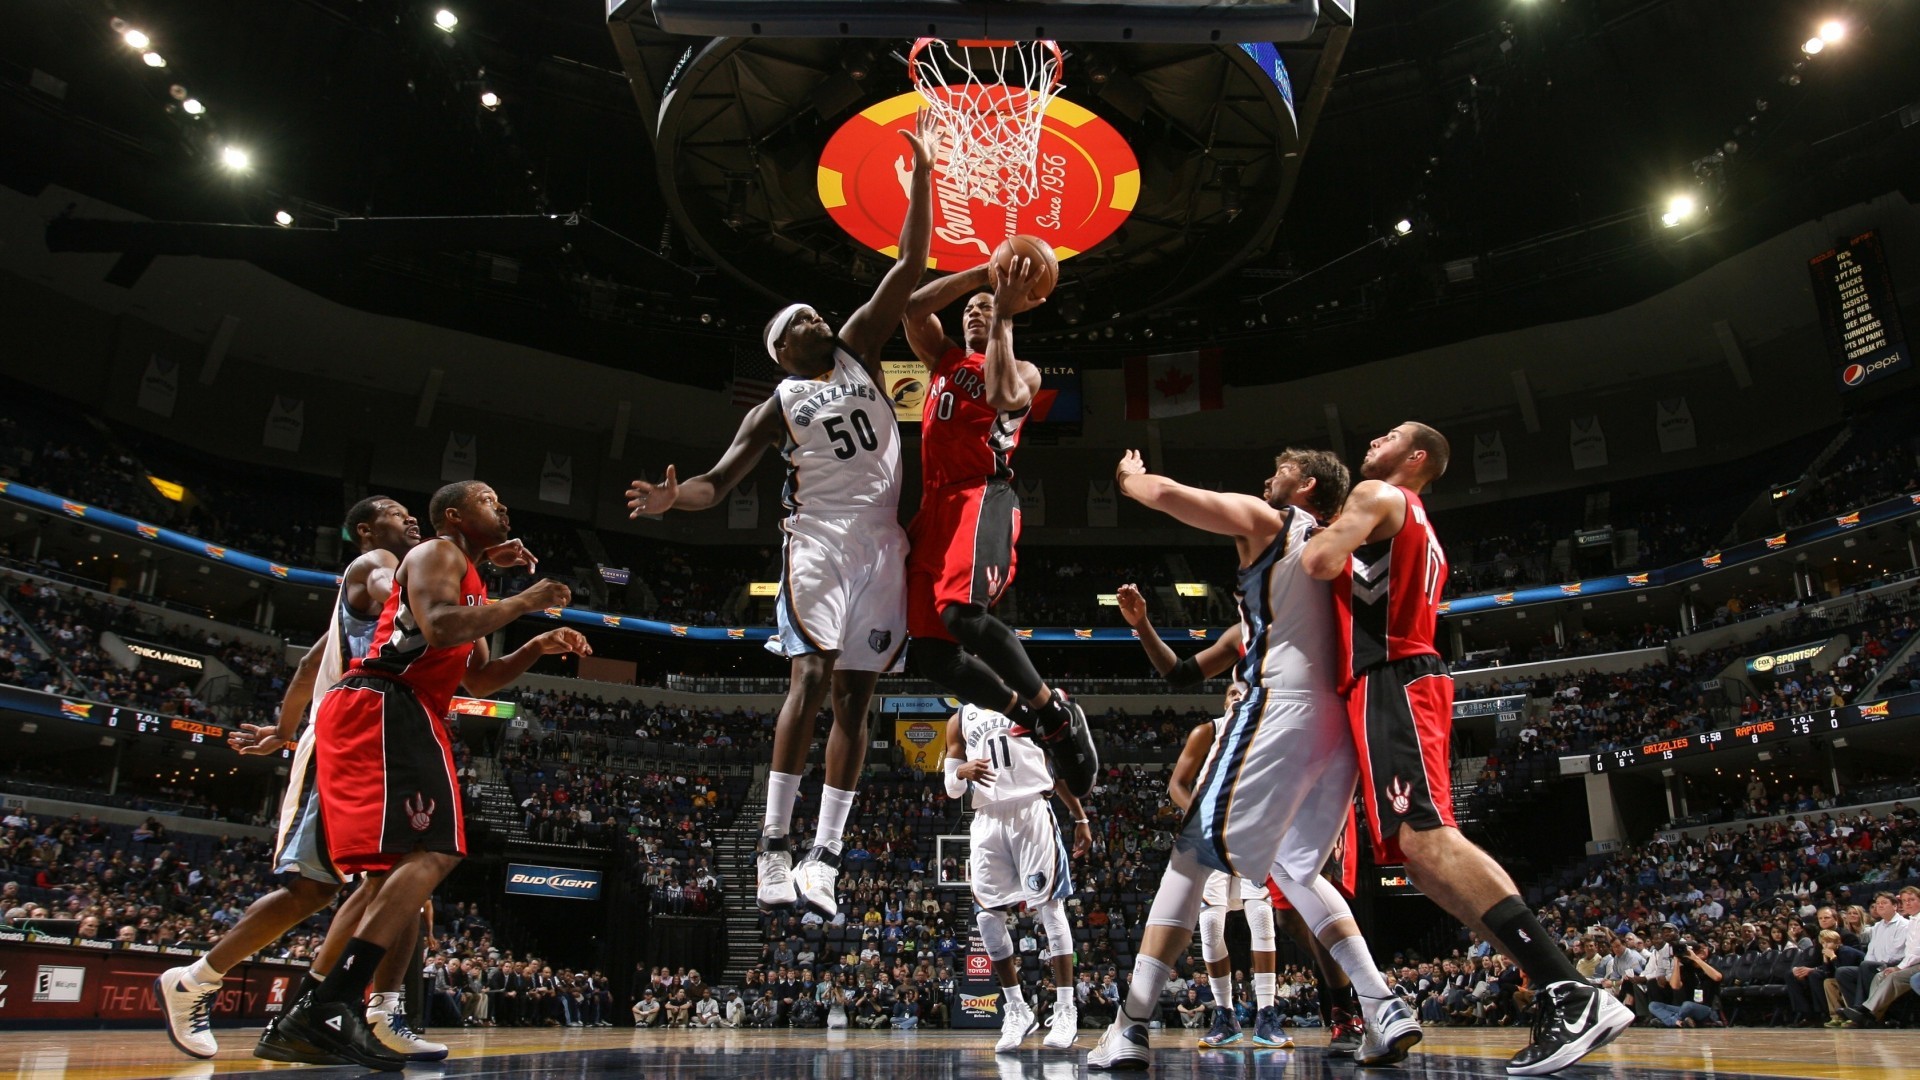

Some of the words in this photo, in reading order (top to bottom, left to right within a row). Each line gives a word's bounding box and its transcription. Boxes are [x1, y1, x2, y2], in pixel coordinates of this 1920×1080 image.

[1041, 153, 1067, 195] 1956
[1036, 196, 1062, 230] Since
[1836, 250, 1852, 262] FG%
[1839, 260, 1854, 270] FT%
[1840, 270, 1848, 280] PT
[1849, 264, 1862, 276] FGS
[1838, 276, 1862, 292] BLOCKS
[1841, 285, 1865, 300] STEALS
[1842, 294, 1868, 310] ASSISTS
[1857, 303, 1872, 314] REB.
[1860, 313, 1875, 324] REB.
[1844, 320, 1881, 340] TURNOVERS
[1844, 342, 1857, 351] PTS
[1858, 338, 1865, 346] IN
[1866, 328, 1884, 342] PAINT
[1848, 344, 1876, 360] FASTBREAK
[1876, 338, 1886, 348] PTS
[1866, 352, 1900, 374] pepsi
[930, 367, 987, 400] RAORS
[795, 383, 876, 427] GRIZZLIES
[822, 408, 878, 460] 50
[1628, 574, 1648, 583] SONIC
[162, 652, 202, 669] MINOLTA
[1758, 658, 1770, 666] FOX
[1777, 664, 1794, 673] 116A
[1704, 680, 1718, 689] 116A
[1830, 710, 1836, 718] F
[1861, 704, 1887, 716] SONIC
[109, 717, 118, 727] 0
[138, 722, 146, 732] 6
[171, 720, 222, 737] GRIZZLIES
[1802, 724, 1810, 734] 5
[1831, 719, 1838, 728] 0
[968, 717, 1017, 748] GRIZZLI
[1736, 722, 1774, 737] RAPTORS
[191, 734, 203, 744] 15
[1644, 738, 1688, 754] GRIZZLIES
[1752, 734, 1758, 744] 8
[283, 750, 290, 758] 8
[988, 736, 1012, 770] 11
[1663, 750, 1672, 760] 15
[1597, 762, 1602, 771] 0
[1619, 758, 1624, 767] 6
[510, 874, 546, 884] BUD
[553, 878, 597, 888] LIGHT
[40, 974, 48, 992] E
[271, 979, 286, 1002] 2K
[101, 986, 139, 1010] THE
[963, 998, 996, 1008] SONIC
